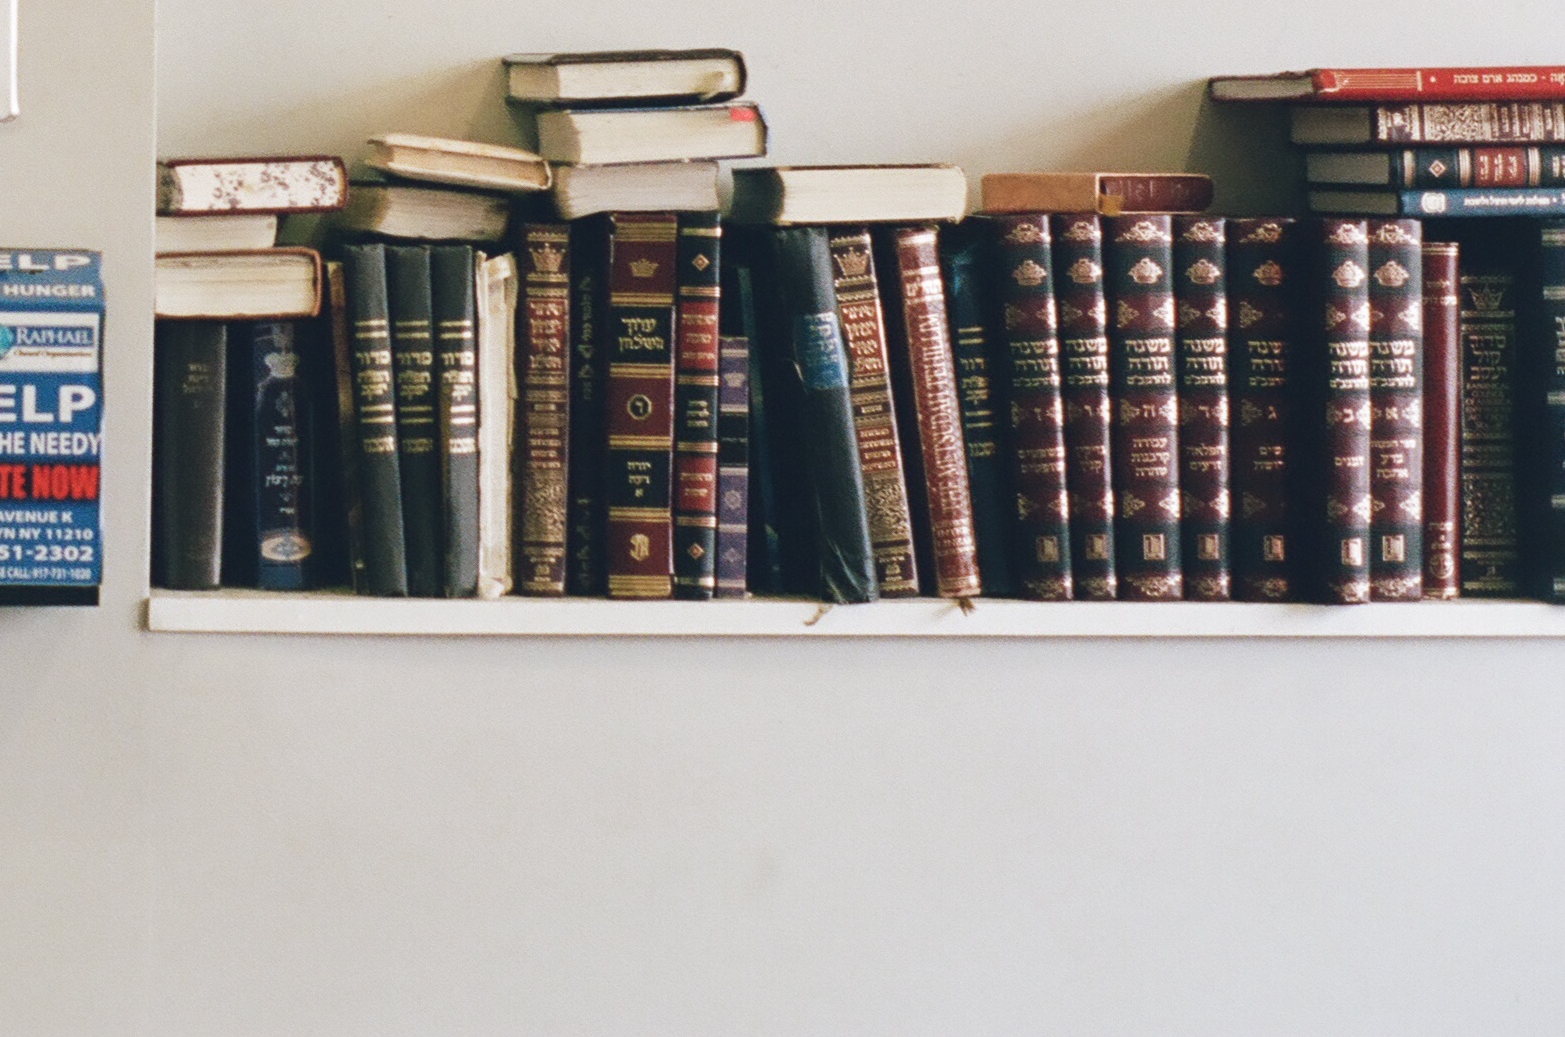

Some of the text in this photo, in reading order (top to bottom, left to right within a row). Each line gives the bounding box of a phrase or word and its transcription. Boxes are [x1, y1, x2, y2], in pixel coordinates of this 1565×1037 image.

[3, 283, 95, 298] HUNGER
[1124, 338, 1171, 353] משנה
[1183, 337, 1224, 353] משנה
[1127, 356, 1169, 371] תורה
[1186, 356, 1223, 371] תורה
[30, 432, 101, 456] NEEDY
[32, 464, 99, 500] NOW
[61, 510, 73, 524] K
[19, 527, 41, 540] NY
[46, 528, 94, 541] 11210
